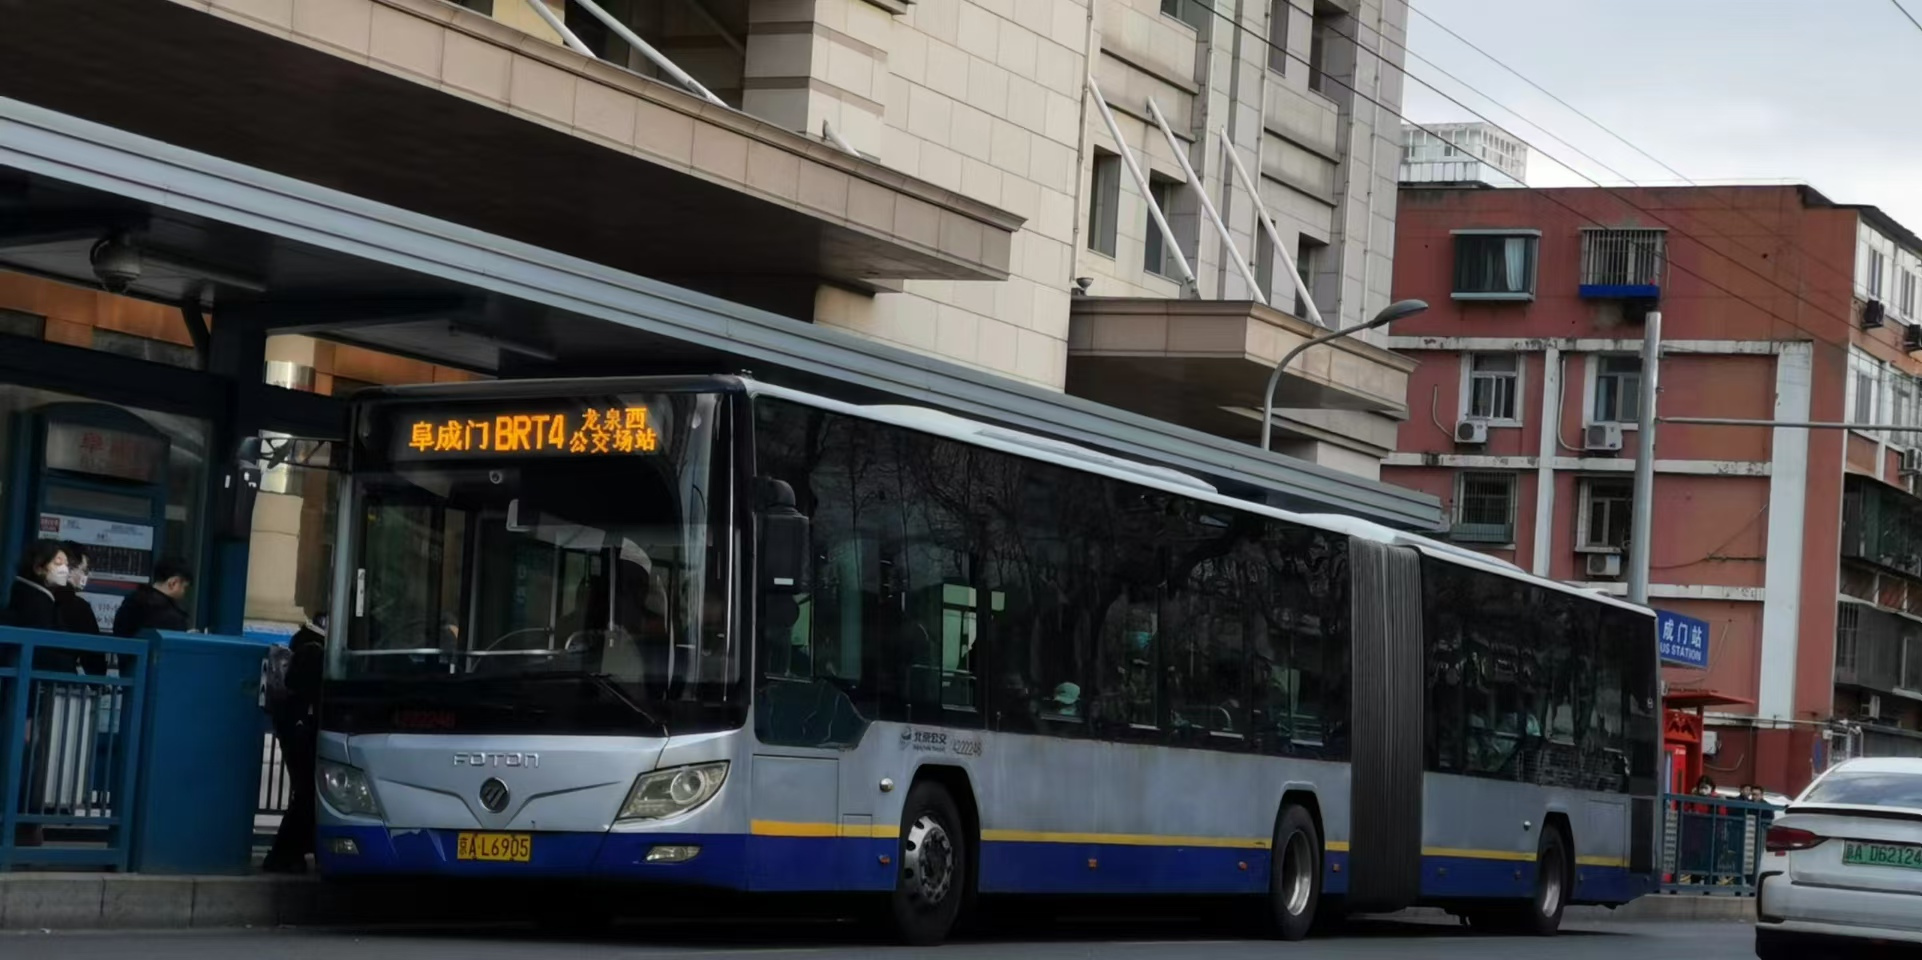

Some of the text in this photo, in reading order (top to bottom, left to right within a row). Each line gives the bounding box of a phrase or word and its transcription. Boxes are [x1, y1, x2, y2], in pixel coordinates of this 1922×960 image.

[581, 406, 648, 431] 龙泉西
[409, 414, 566, 452] 阜成门 BRT4
[569, 429, 657, 453] 公交场站
[1671, 644, 1702, 661] STATION
[913, 731, 947, 745] 北京公交
[453, 752, 540, 767] FOTON
